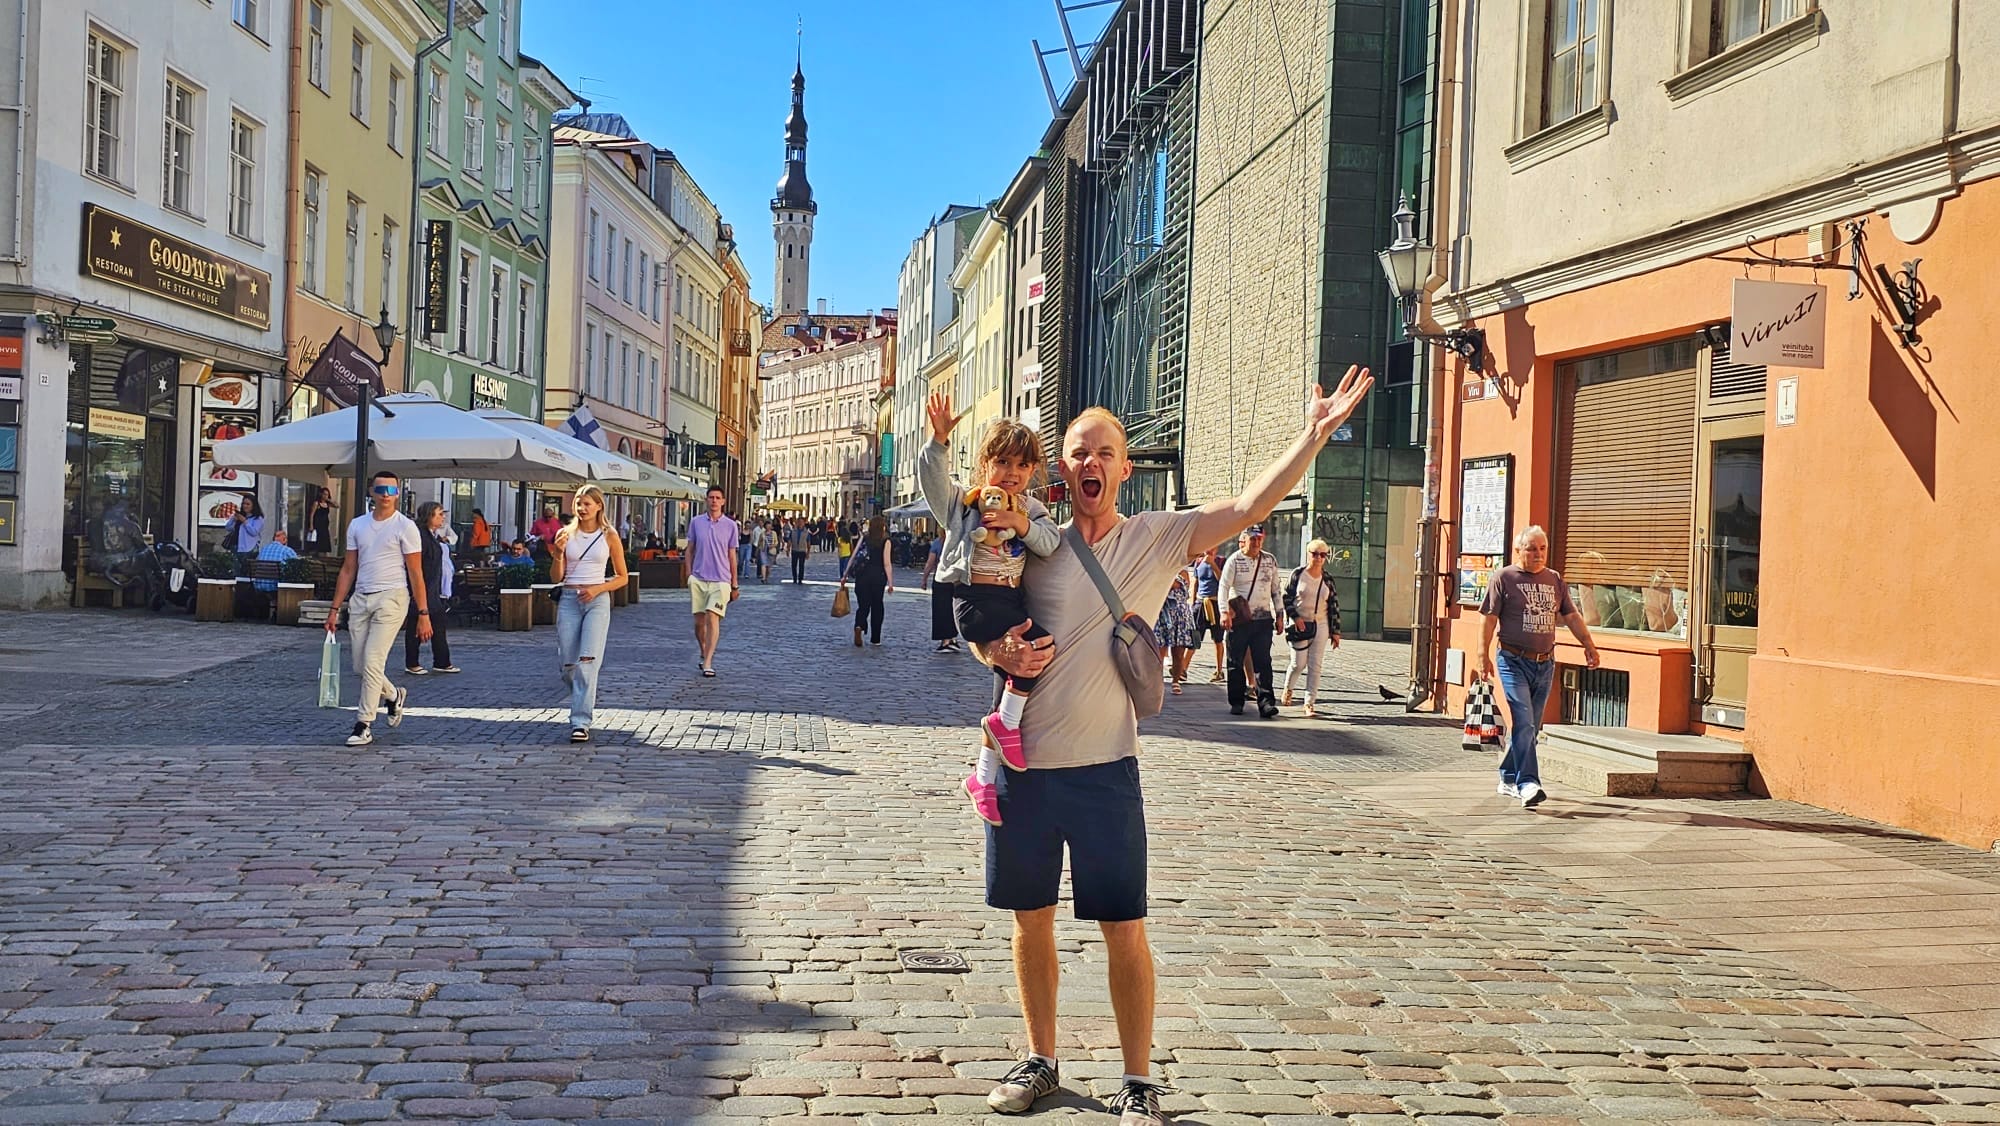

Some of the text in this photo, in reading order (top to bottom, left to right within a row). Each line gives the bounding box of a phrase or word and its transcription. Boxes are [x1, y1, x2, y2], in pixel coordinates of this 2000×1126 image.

[95, 257, 134, 279] RESTORAN
[149, 238, 228, 290] GOODWIN
[429, 222, 444, 330] PAPARAZZI
[157, 278, 219, 306] THE STEAK HOUSE
[240, 305, 267, 322] RESTORAN
[1741, 291, 1818, 349] Viru17
[1781, 343, 1814, 351] veinituba
[474, 373, 508, 401] HELSINKI
[1467, 385, 1480, 397] Viru
[1726, 591, 1753, 606] VIRU17
